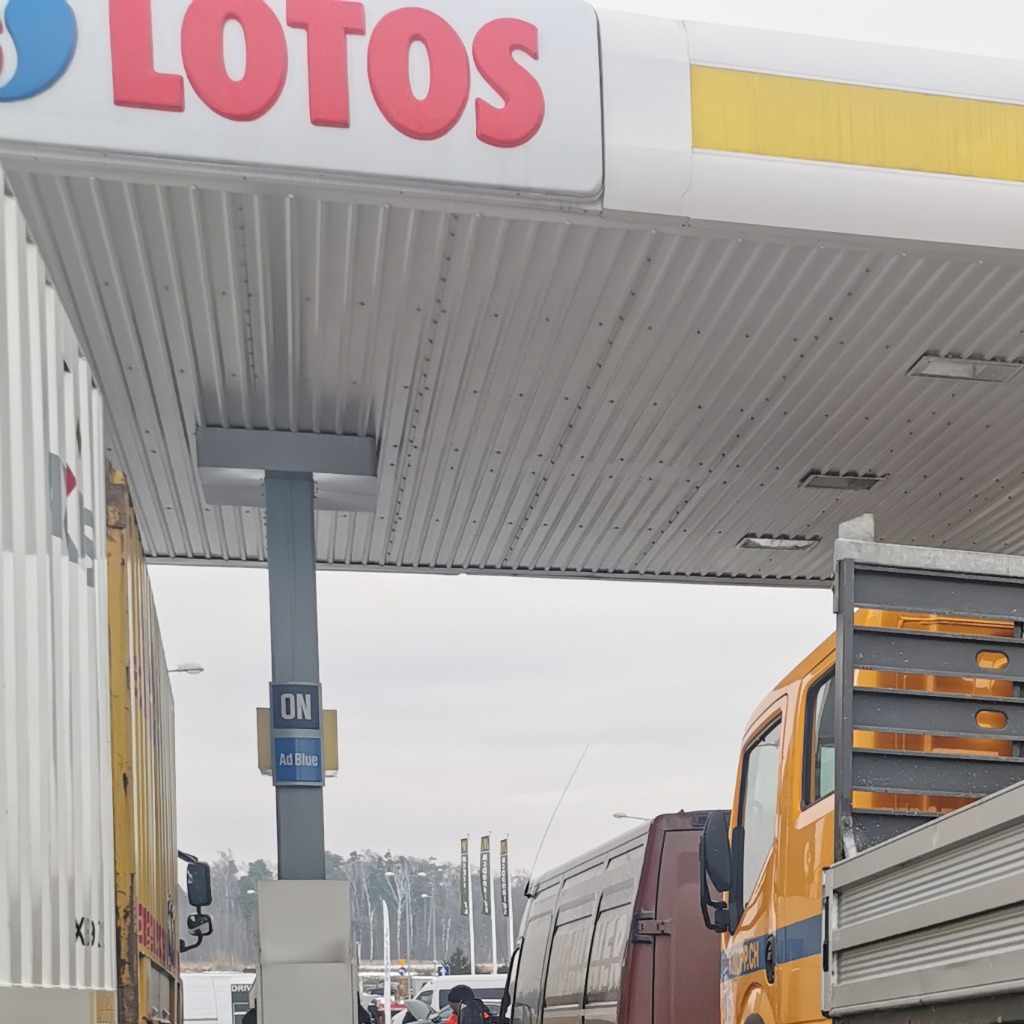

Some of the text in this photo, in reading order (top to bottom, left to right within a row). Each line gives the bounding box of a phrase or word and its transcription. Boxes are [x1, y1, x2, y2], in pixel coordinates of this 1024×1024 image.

[108, 0, 546, 149] LOTOS
[280, 692, 312, 720] ON
[279, 752, 319, 767] Ad Blue
[231, 984, 253, 993] DRIV
